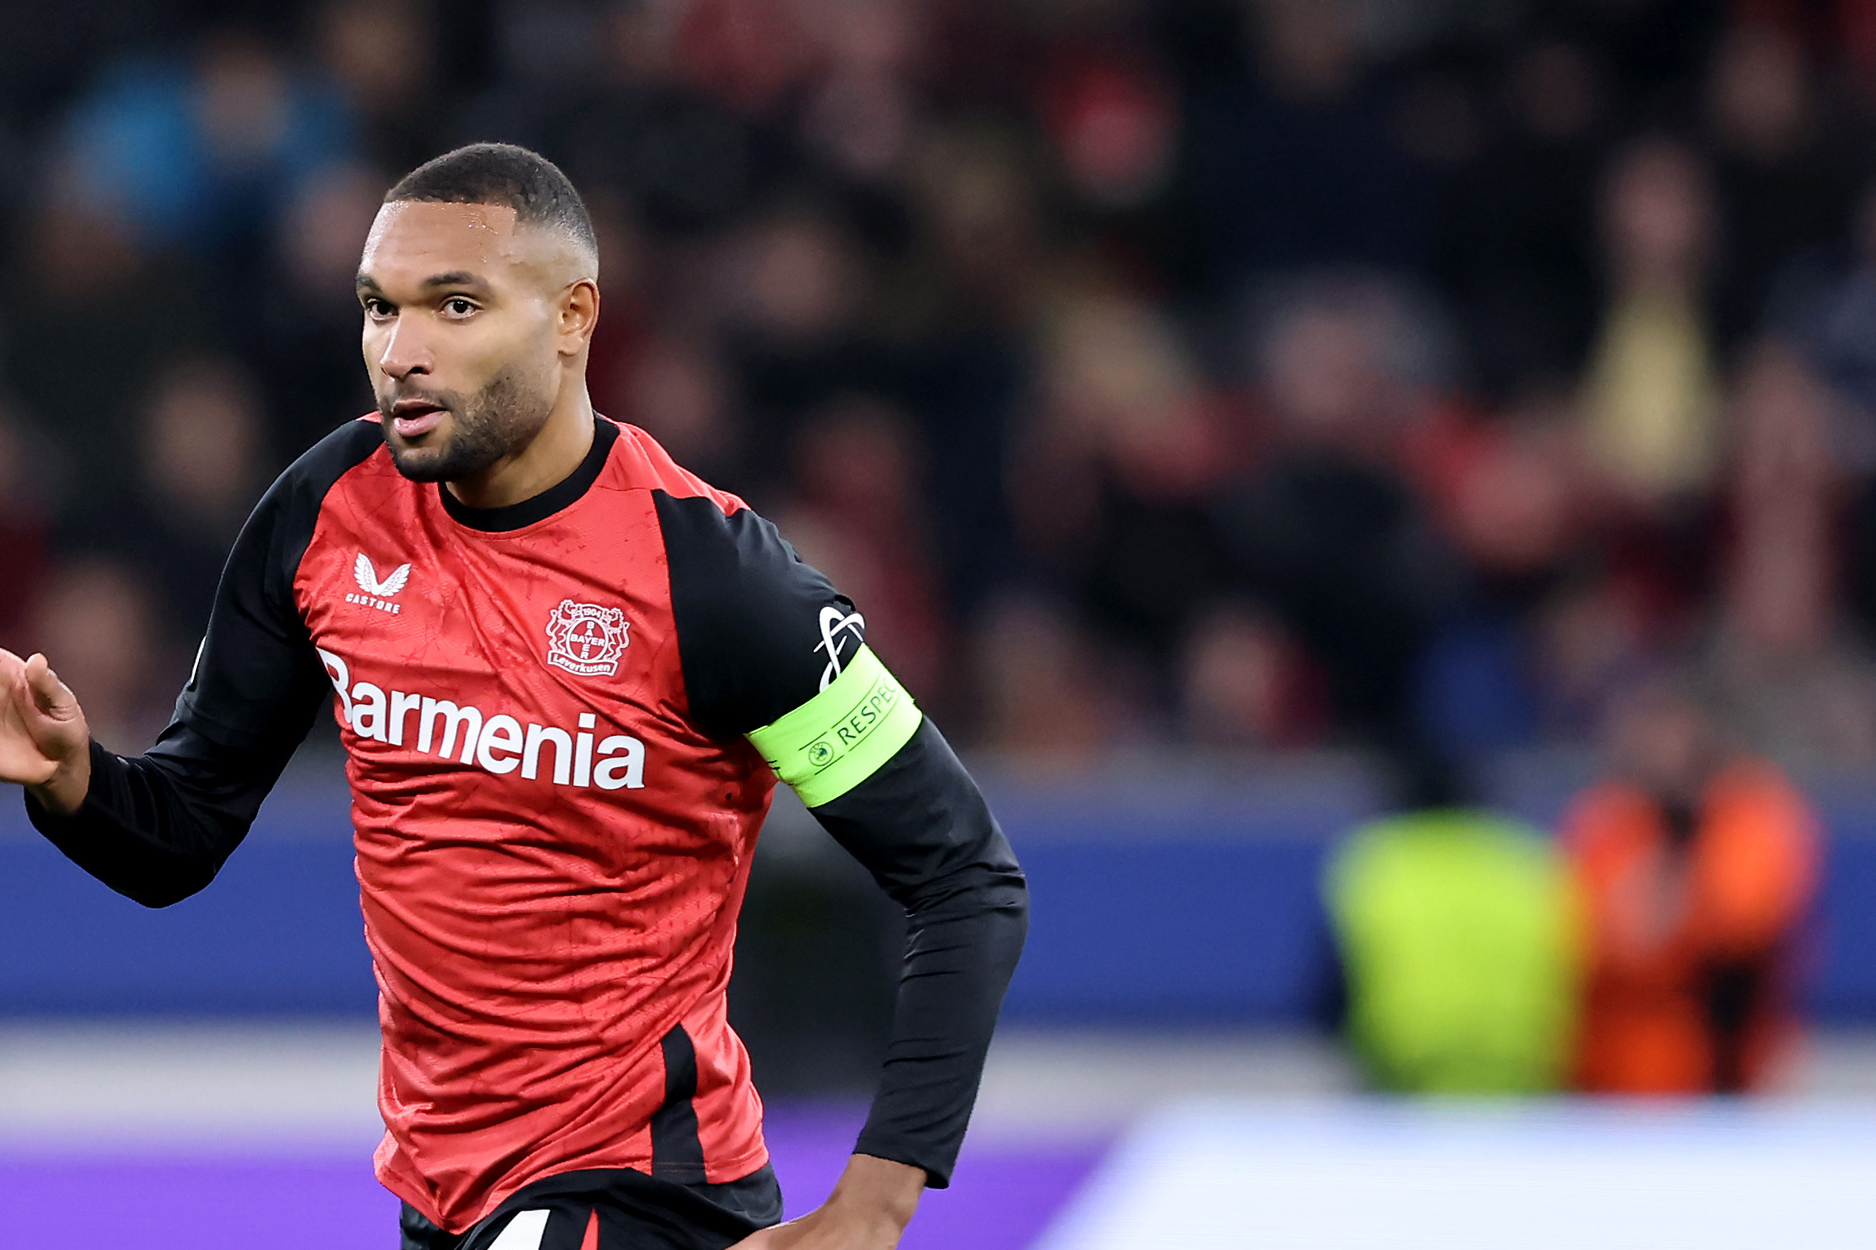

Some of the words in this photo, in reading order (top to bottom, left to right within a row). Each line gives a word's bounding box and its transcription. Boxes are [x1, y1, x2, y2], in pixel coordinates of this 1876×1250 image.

[345, 593, 401, 614] CASTORE
[583, 607, 601, 617] 1904
[570, 633, 605, 646] BAYER
[580, 621, 595, 659] BAYER
[552, 654, 611, 672] Leverkusen
[315, 646, 646, 789] Barmenia
